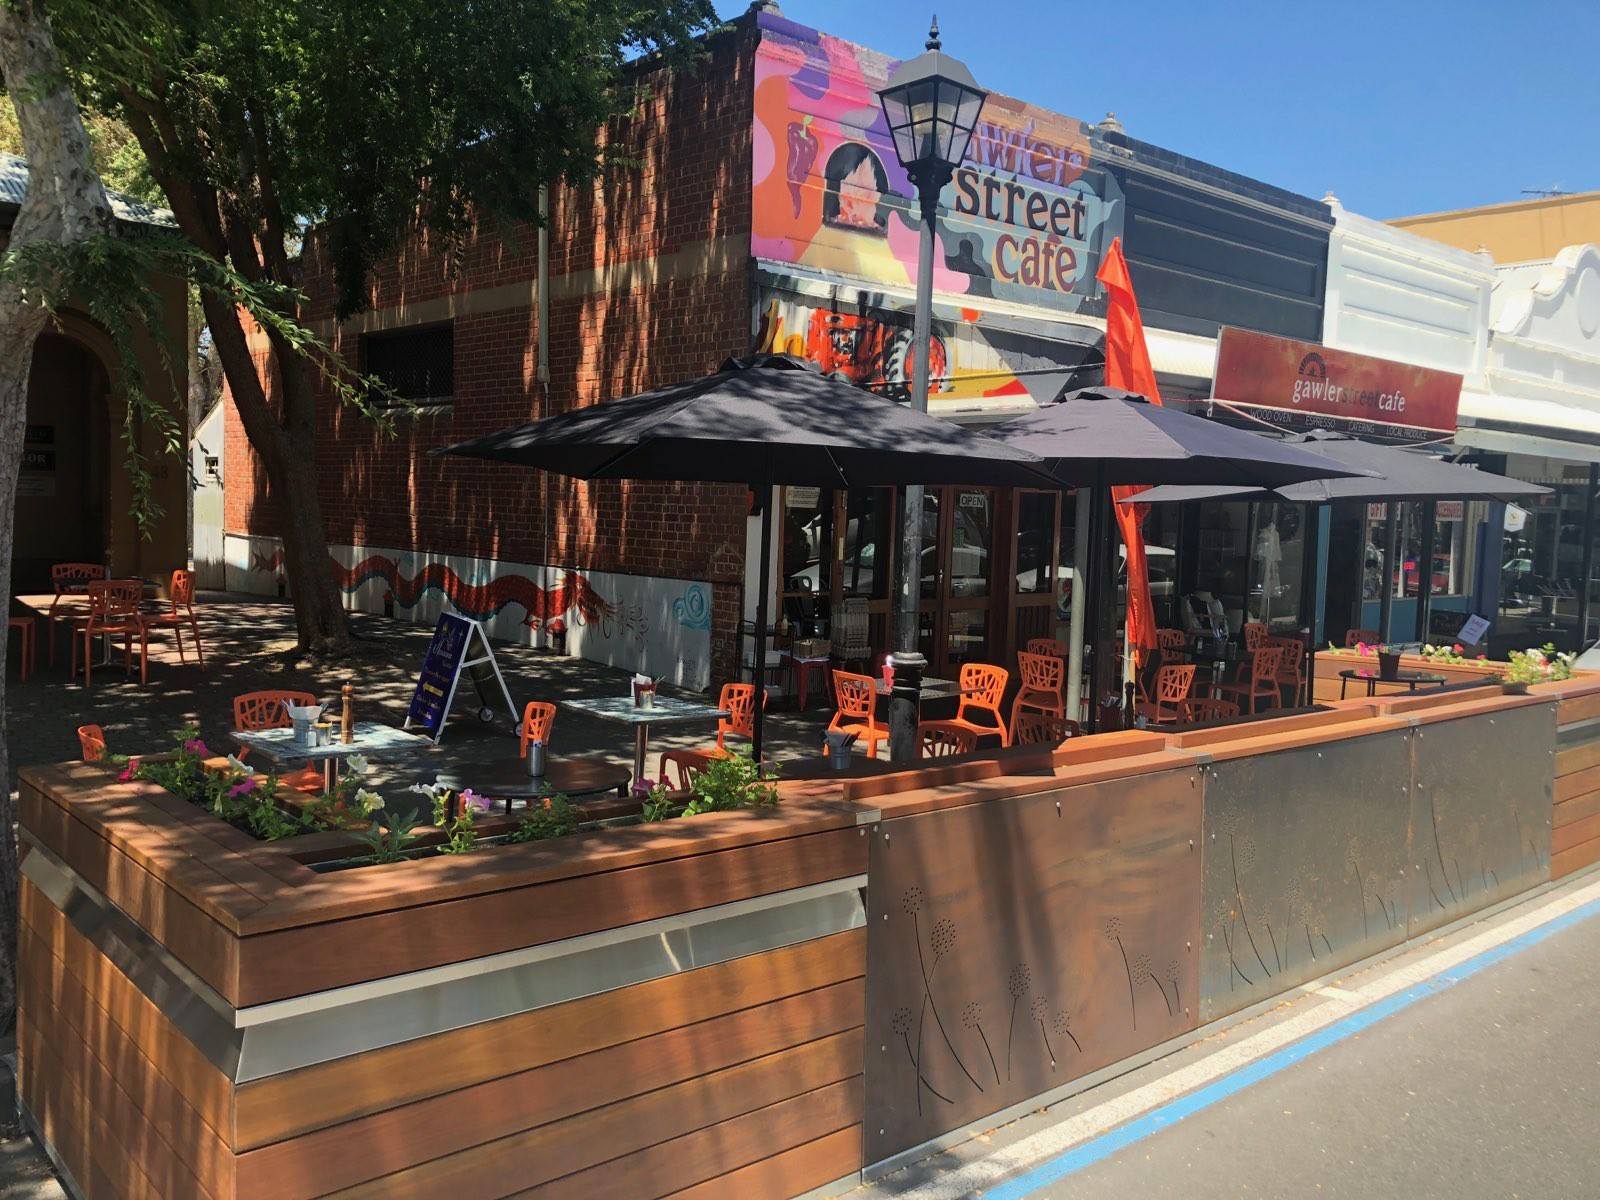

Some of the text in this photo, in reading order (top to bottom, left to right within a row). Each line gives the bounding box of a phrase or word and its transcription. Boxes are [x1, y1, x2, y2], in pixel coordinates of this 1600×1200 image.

[1292, 377, 1343, 404] gawler
[1378, 390, 1406, 412] cafe
[1273, 411, 1292, 423] OVEN
[1305, 415, 1336, 429] ESPRESSO
[961, 495, 983, 506] OPEN
